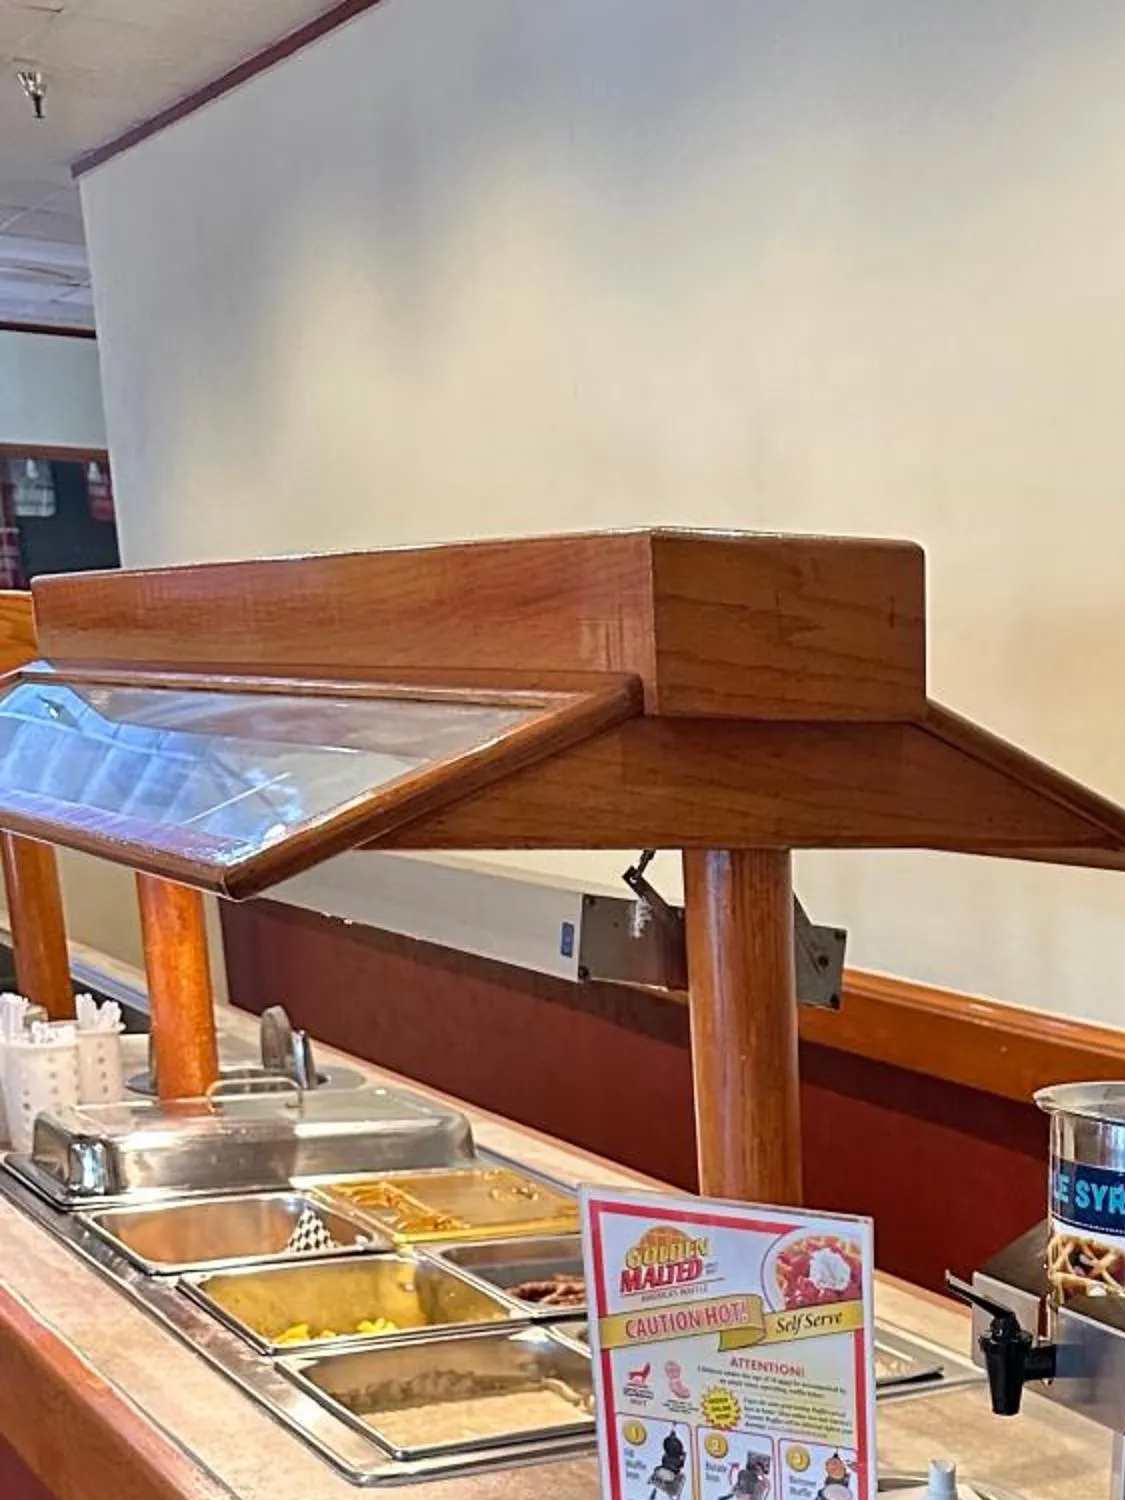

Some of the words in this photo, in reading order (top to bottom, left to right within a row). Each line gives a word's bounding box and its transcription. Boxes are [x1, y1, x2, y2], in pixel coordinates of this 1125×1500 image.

[625, 1237, 709, 1270] GOLDEN
[620, 1256, 704, 1293] MALTED
[624, 1310, 700, 1339] CAUTION
[705, 1301, 748, 1325] HOT!
[775, 1316, 802, 1335] Self
[805, 1310, 844, 1327] Serve
[730, 1357, 805, 1377] ATTENTION!
